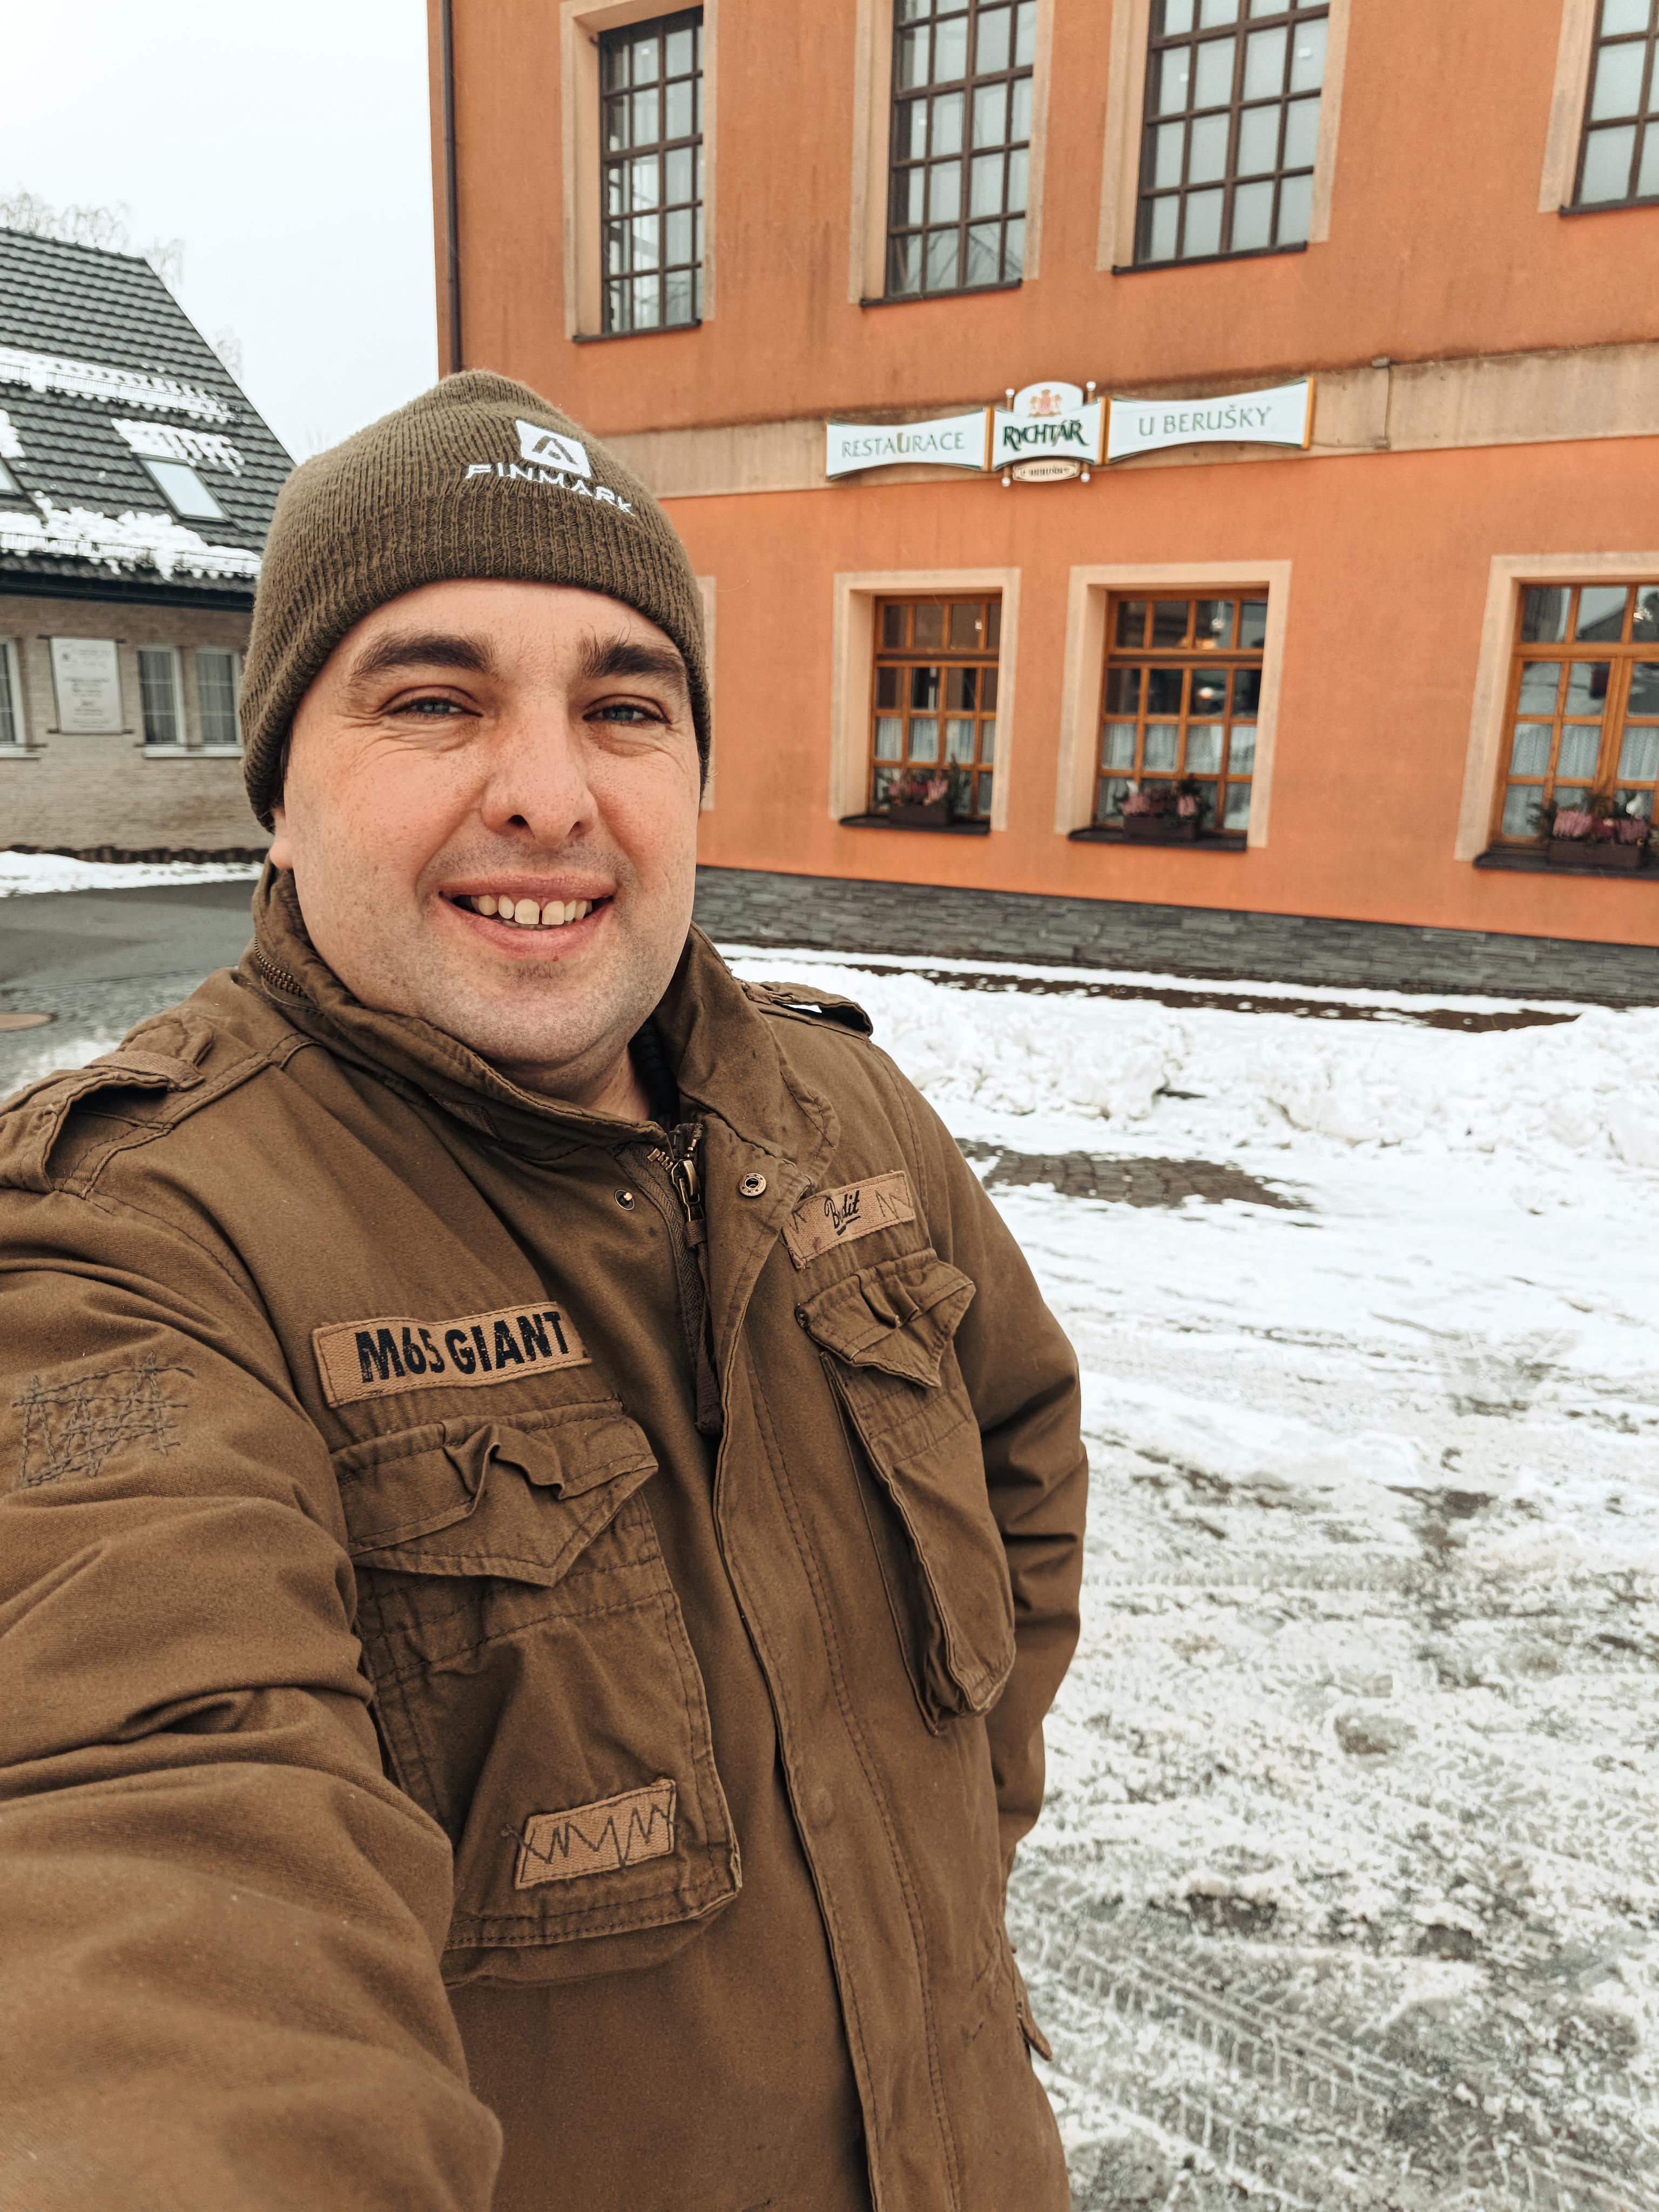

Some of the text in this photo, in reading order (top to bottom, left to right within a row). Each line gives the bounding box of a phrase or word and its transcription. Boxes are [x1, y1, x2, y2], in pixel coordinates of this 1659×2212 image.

[1003, 419, 1089, 452] RYCHTÁŘ
[1139, 403, 1272, 436] U BERUŠKY
[842, 431, 965, 458] RESTAURACE
[465, 463, 635, 516] FINMARK
[445, 1311, 569, 1374] GIANT
